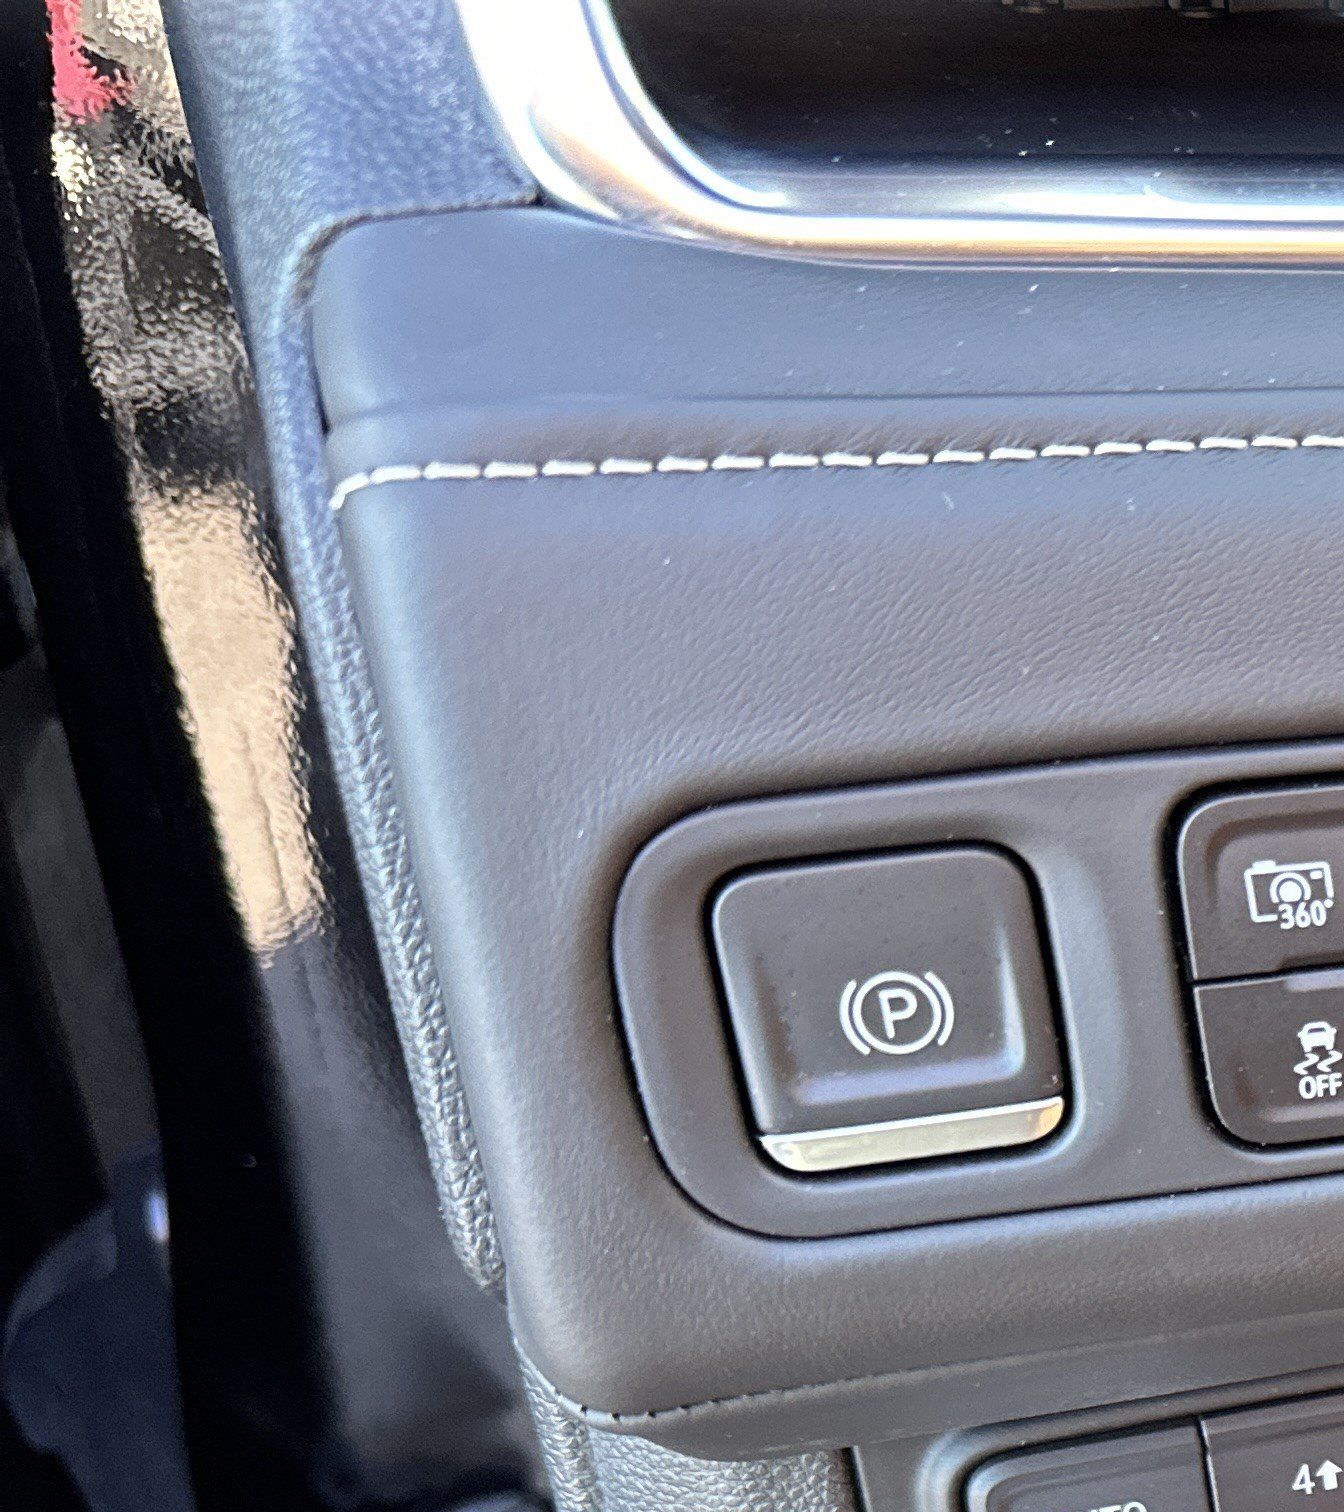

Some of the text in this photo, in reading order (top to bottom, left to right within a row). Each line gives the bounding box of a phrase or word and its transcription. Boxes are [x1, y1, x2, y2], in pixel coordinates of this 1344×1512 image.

[878, 988, 918, 1040] P
[1299, 1073, 1343, 1099] OFF
[1292, 1463, 1316, 1495] 4
